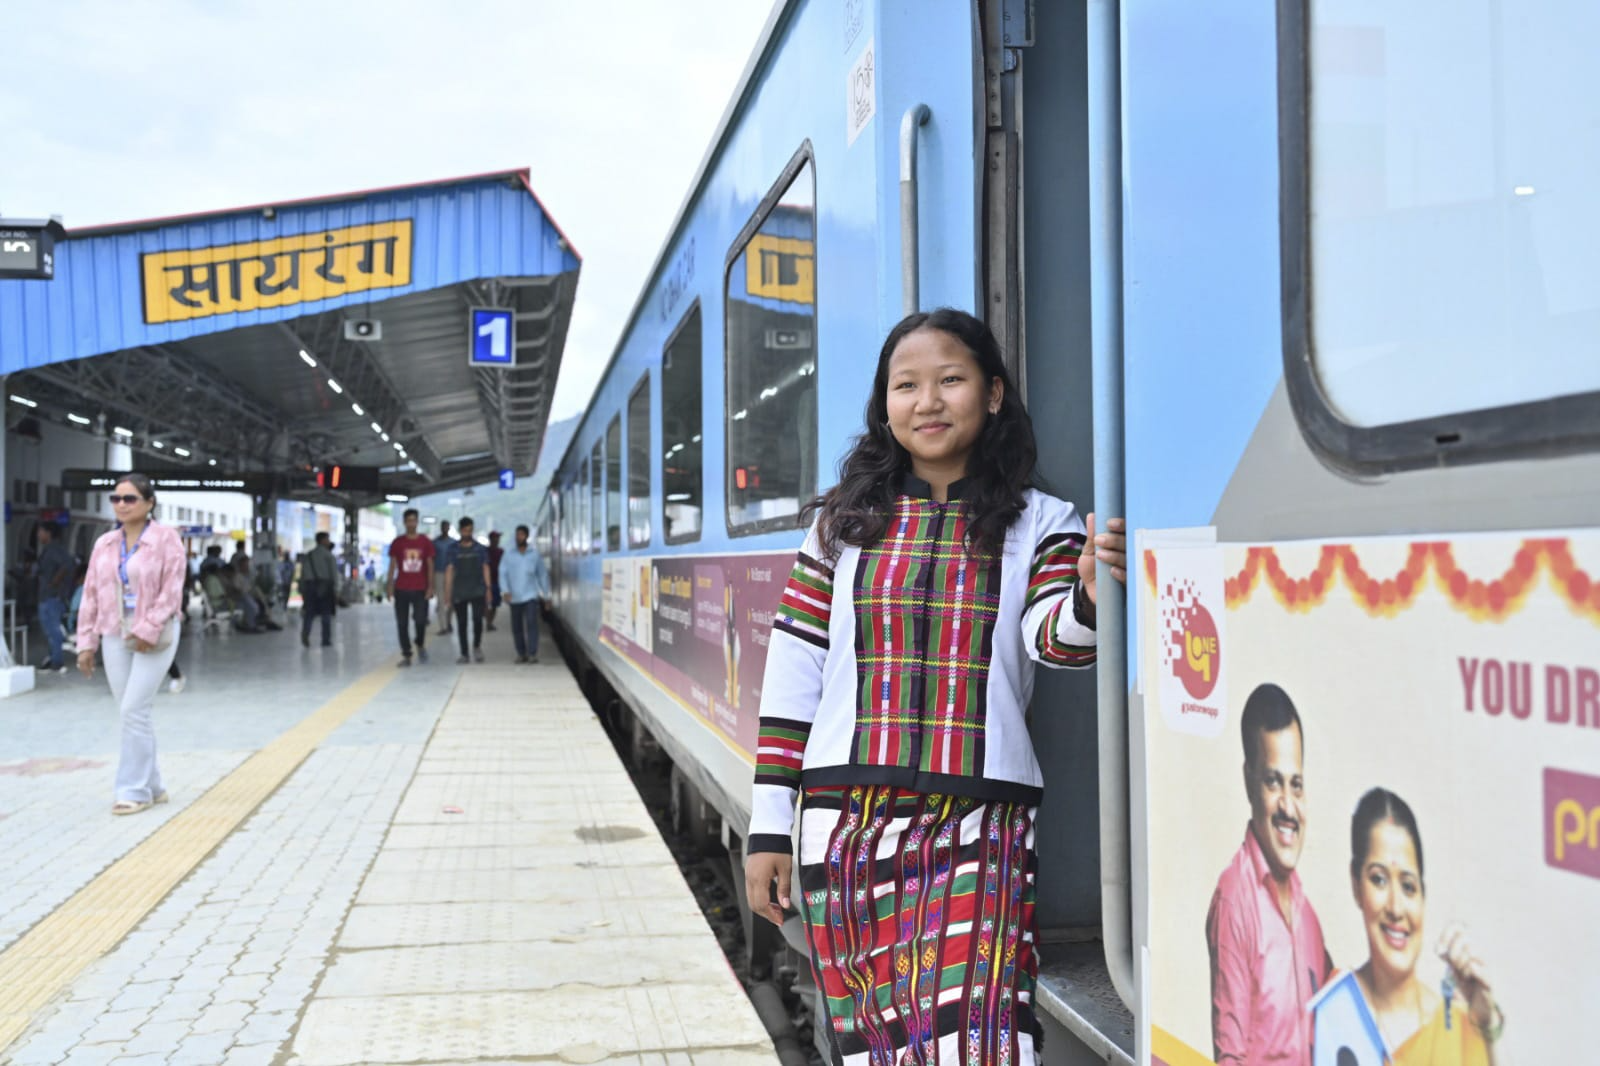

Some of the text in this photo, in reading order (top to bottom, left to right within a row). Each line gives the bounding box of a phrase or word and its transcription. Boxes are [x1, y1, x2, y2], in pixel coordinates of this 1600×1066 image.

[478, 317, 507, 357] 1
[500, 470, 514, 488] 1
[1458, 657, 1531, 720] YOU
